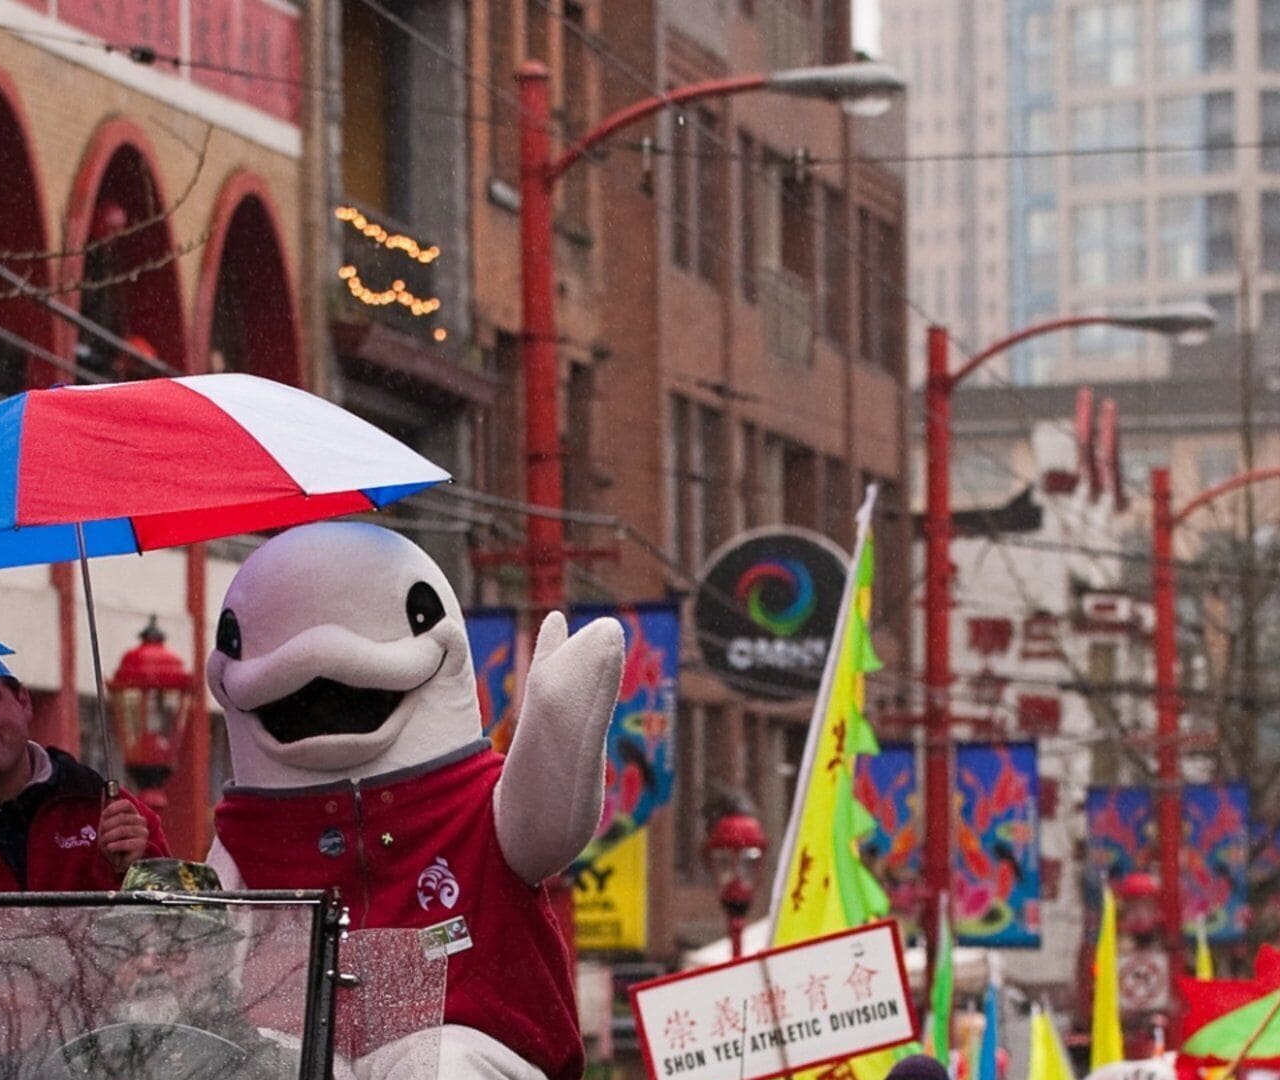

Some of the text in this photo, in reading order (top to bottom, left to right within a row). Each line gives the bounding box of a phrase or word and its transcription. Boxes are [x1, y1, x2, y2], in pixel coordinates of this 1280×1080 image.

[664, 998, 900, 1077] SHON YEE ATHLETIC DIVISION
